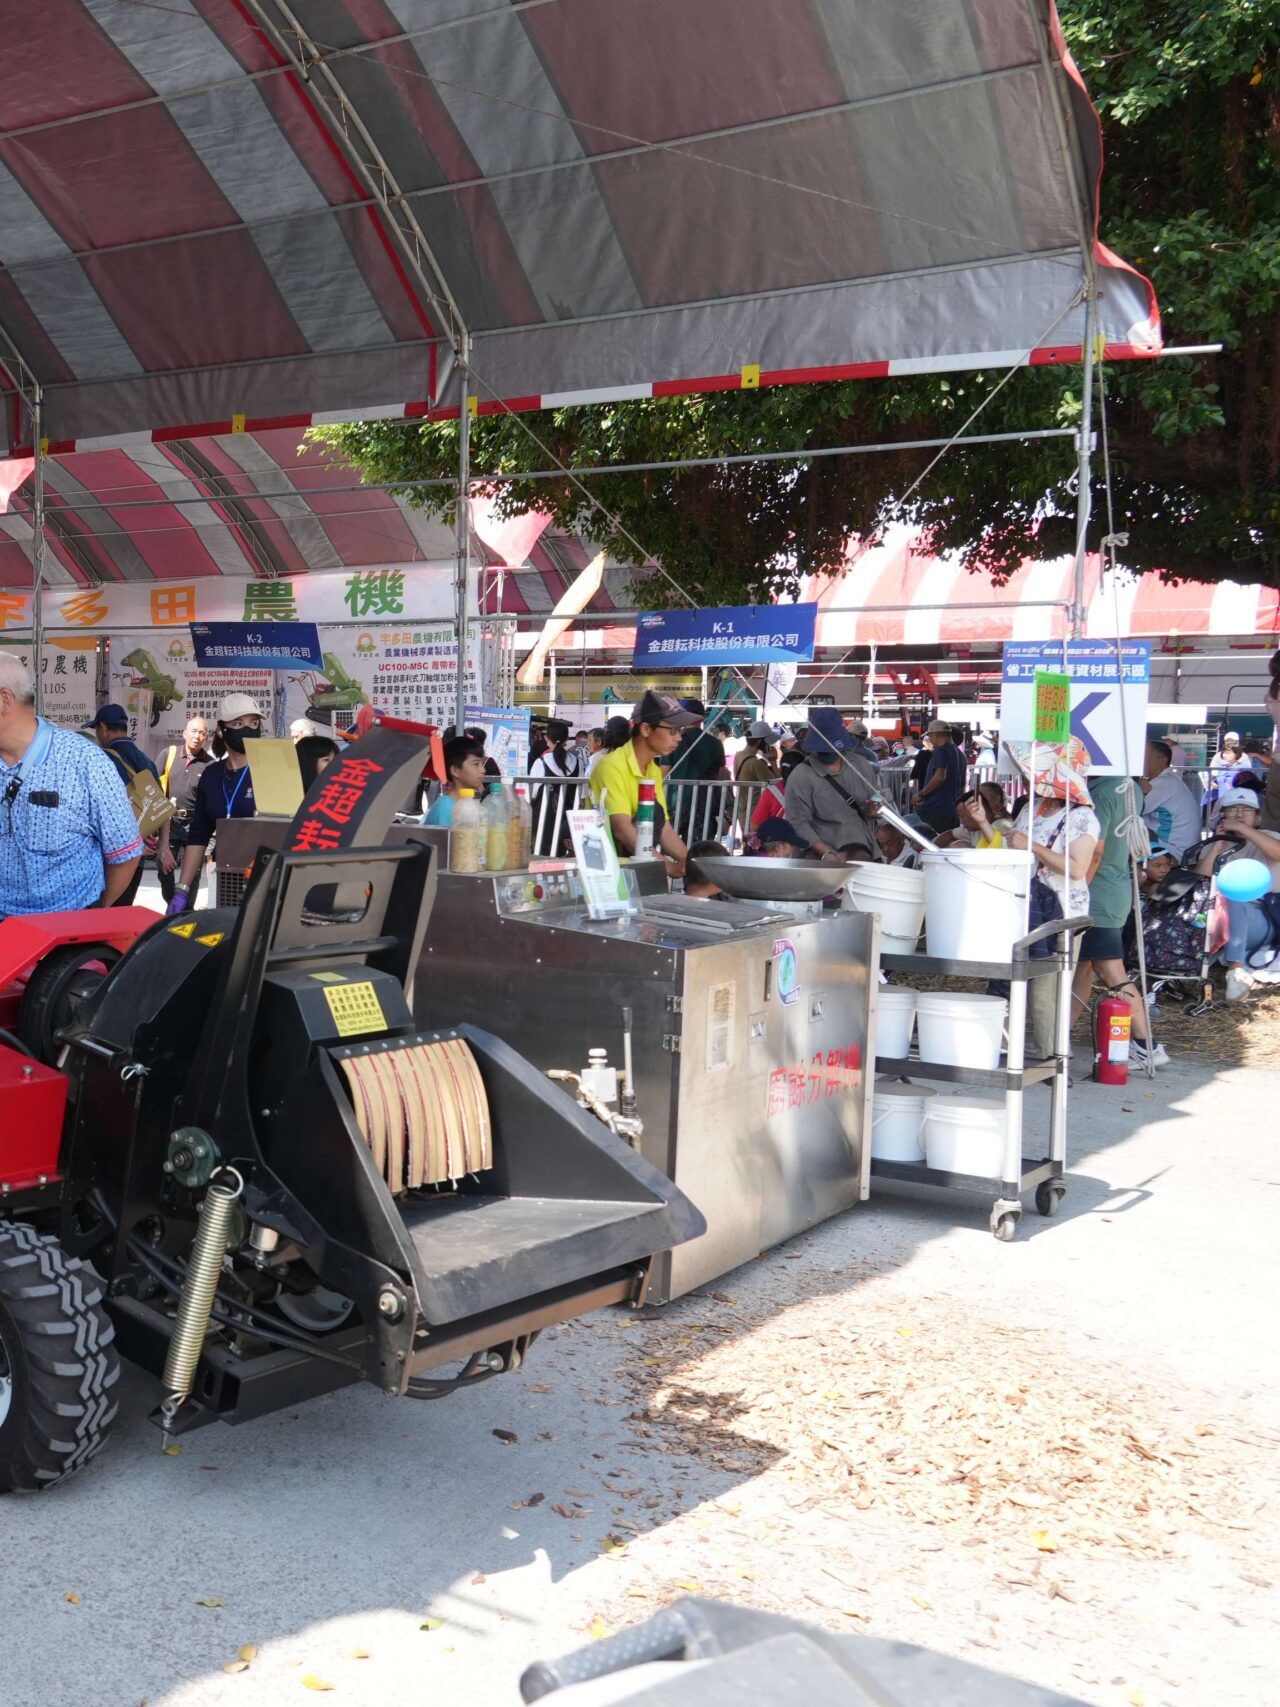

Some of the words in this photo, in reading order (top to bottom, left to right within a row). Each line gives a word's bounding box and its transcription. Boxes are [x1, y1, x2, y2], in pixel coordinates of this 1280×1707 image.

[712, 621, 735, 634] K-1
[246, 633, 263, 644] K-2
[380, 629, 476, 644] 宇多田農機有限司
[647, 633, 799, 653] 金超耘科技股份有限公司
[204, 645, 311, 658] 金超耘科技股份有限公司
[378, 662, 429, 671] UC100-MSC
[291, 758, 384, 852] 金超耘
